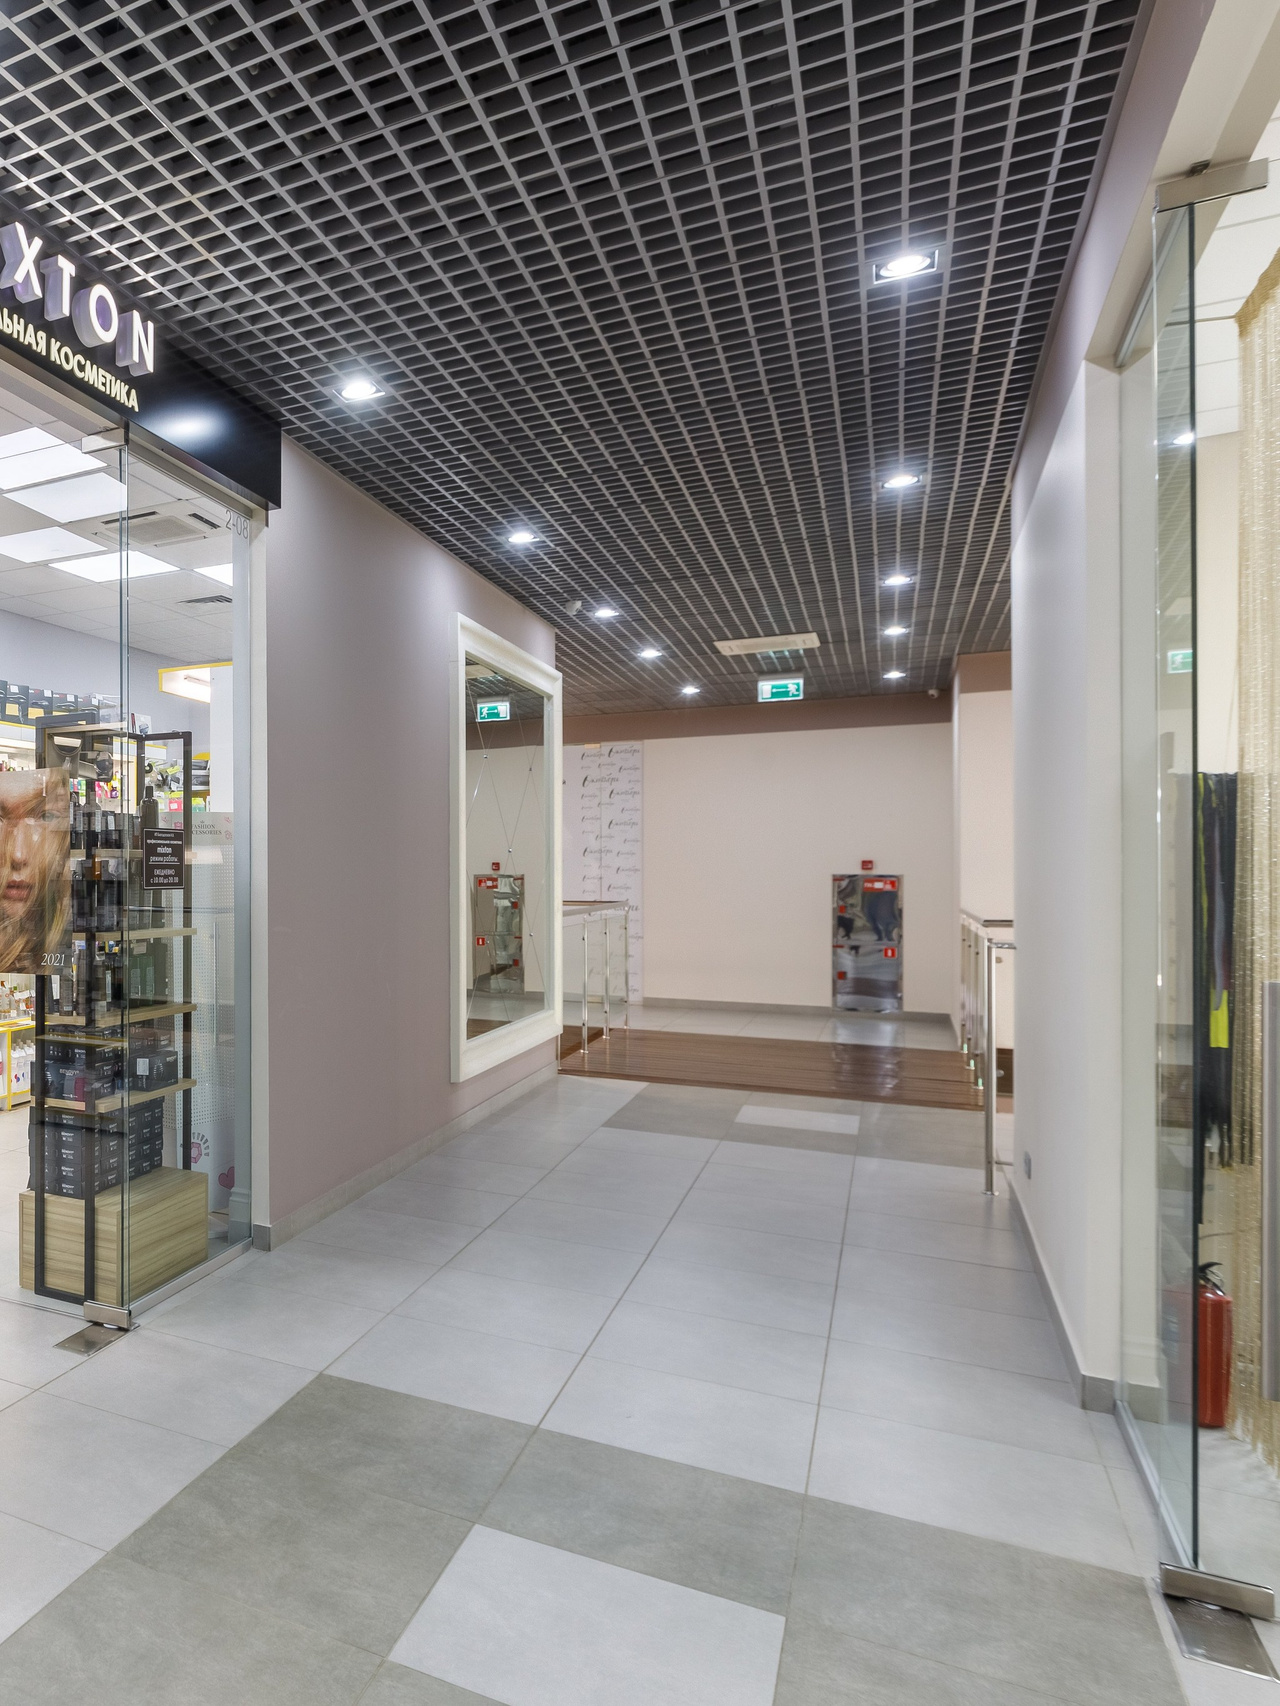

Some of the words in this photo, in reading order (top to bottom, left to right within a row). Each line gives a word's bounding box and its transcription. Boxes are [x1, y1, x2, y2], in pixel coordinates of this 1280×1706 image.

[49, 336, 139, 412] КОСМЕТИКА
[225, 509, 249, 540] 2-08
[40, 952, 66, 967] 2021
